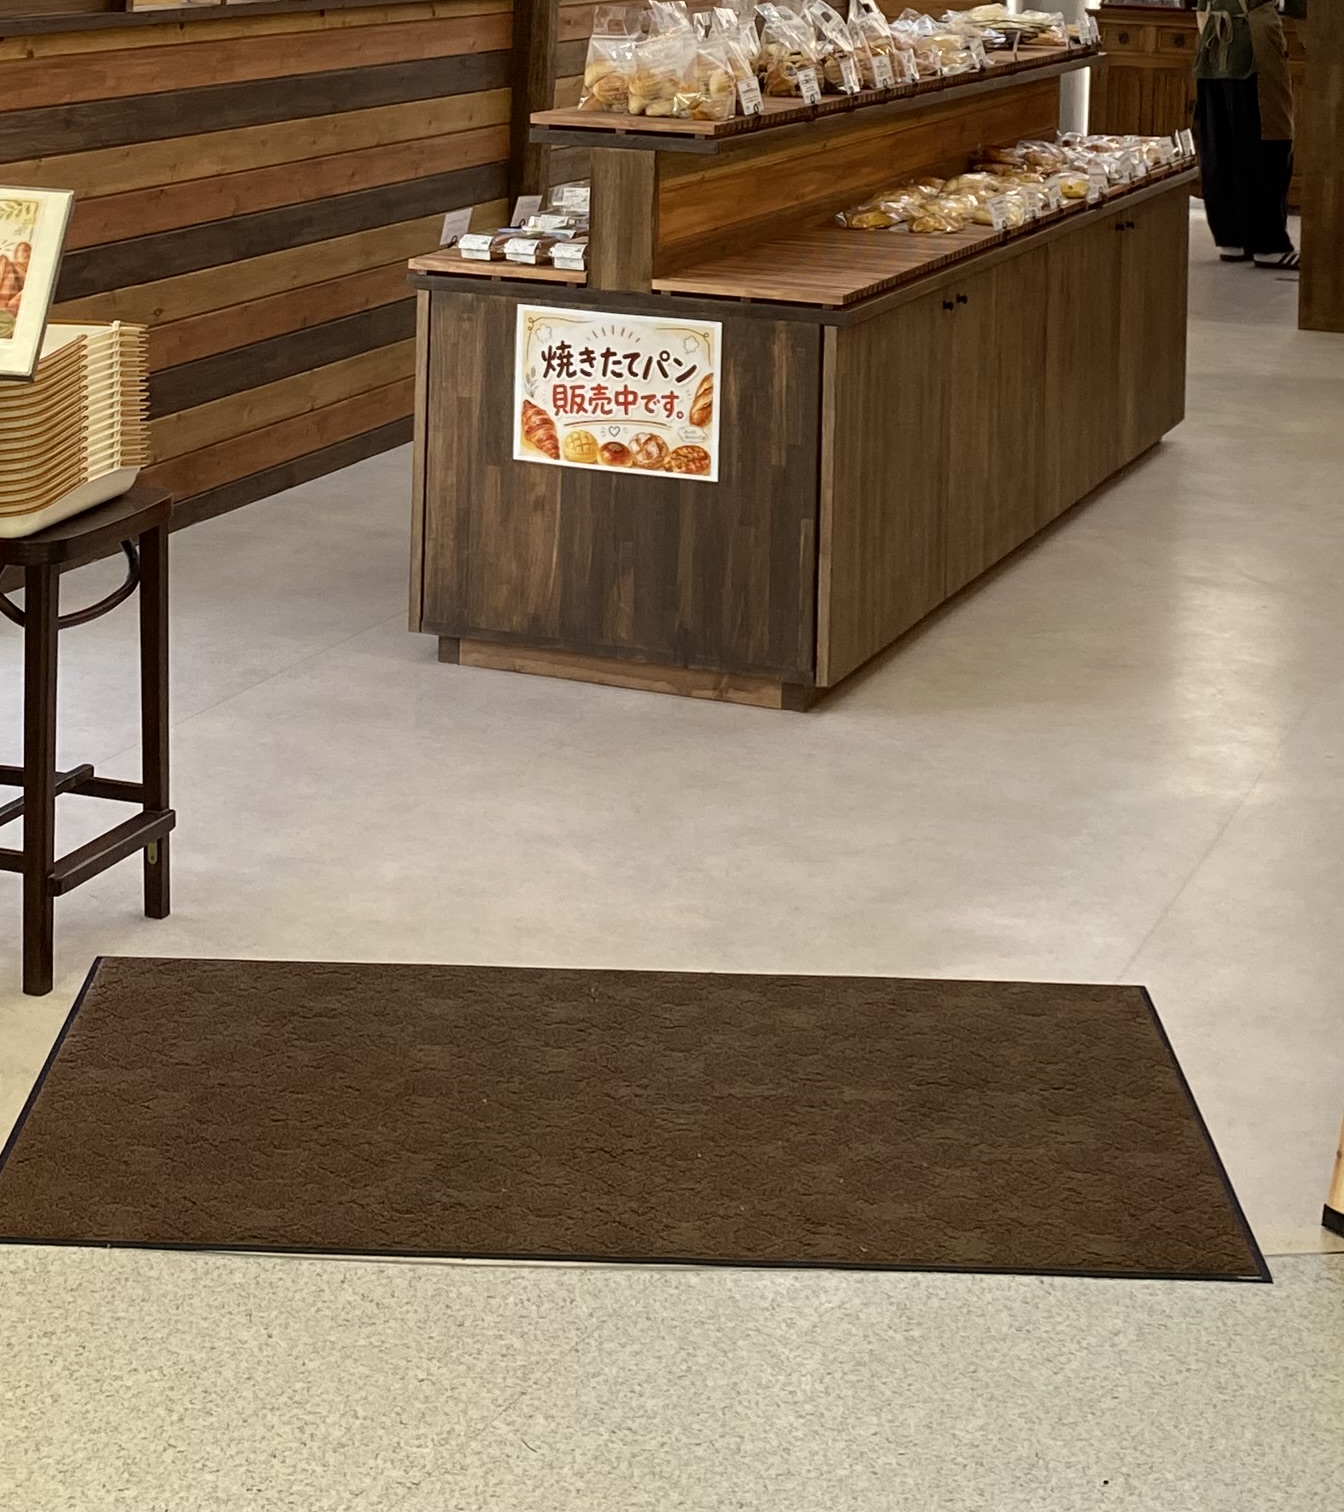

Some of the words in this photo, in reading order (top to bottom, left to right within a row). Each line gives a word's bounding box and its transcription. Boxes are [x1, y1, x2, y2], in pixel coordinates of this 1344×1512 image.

[541, 341, 698, 383] 焼きたてパン
[552, 383, 684, 419] 販売中です。
